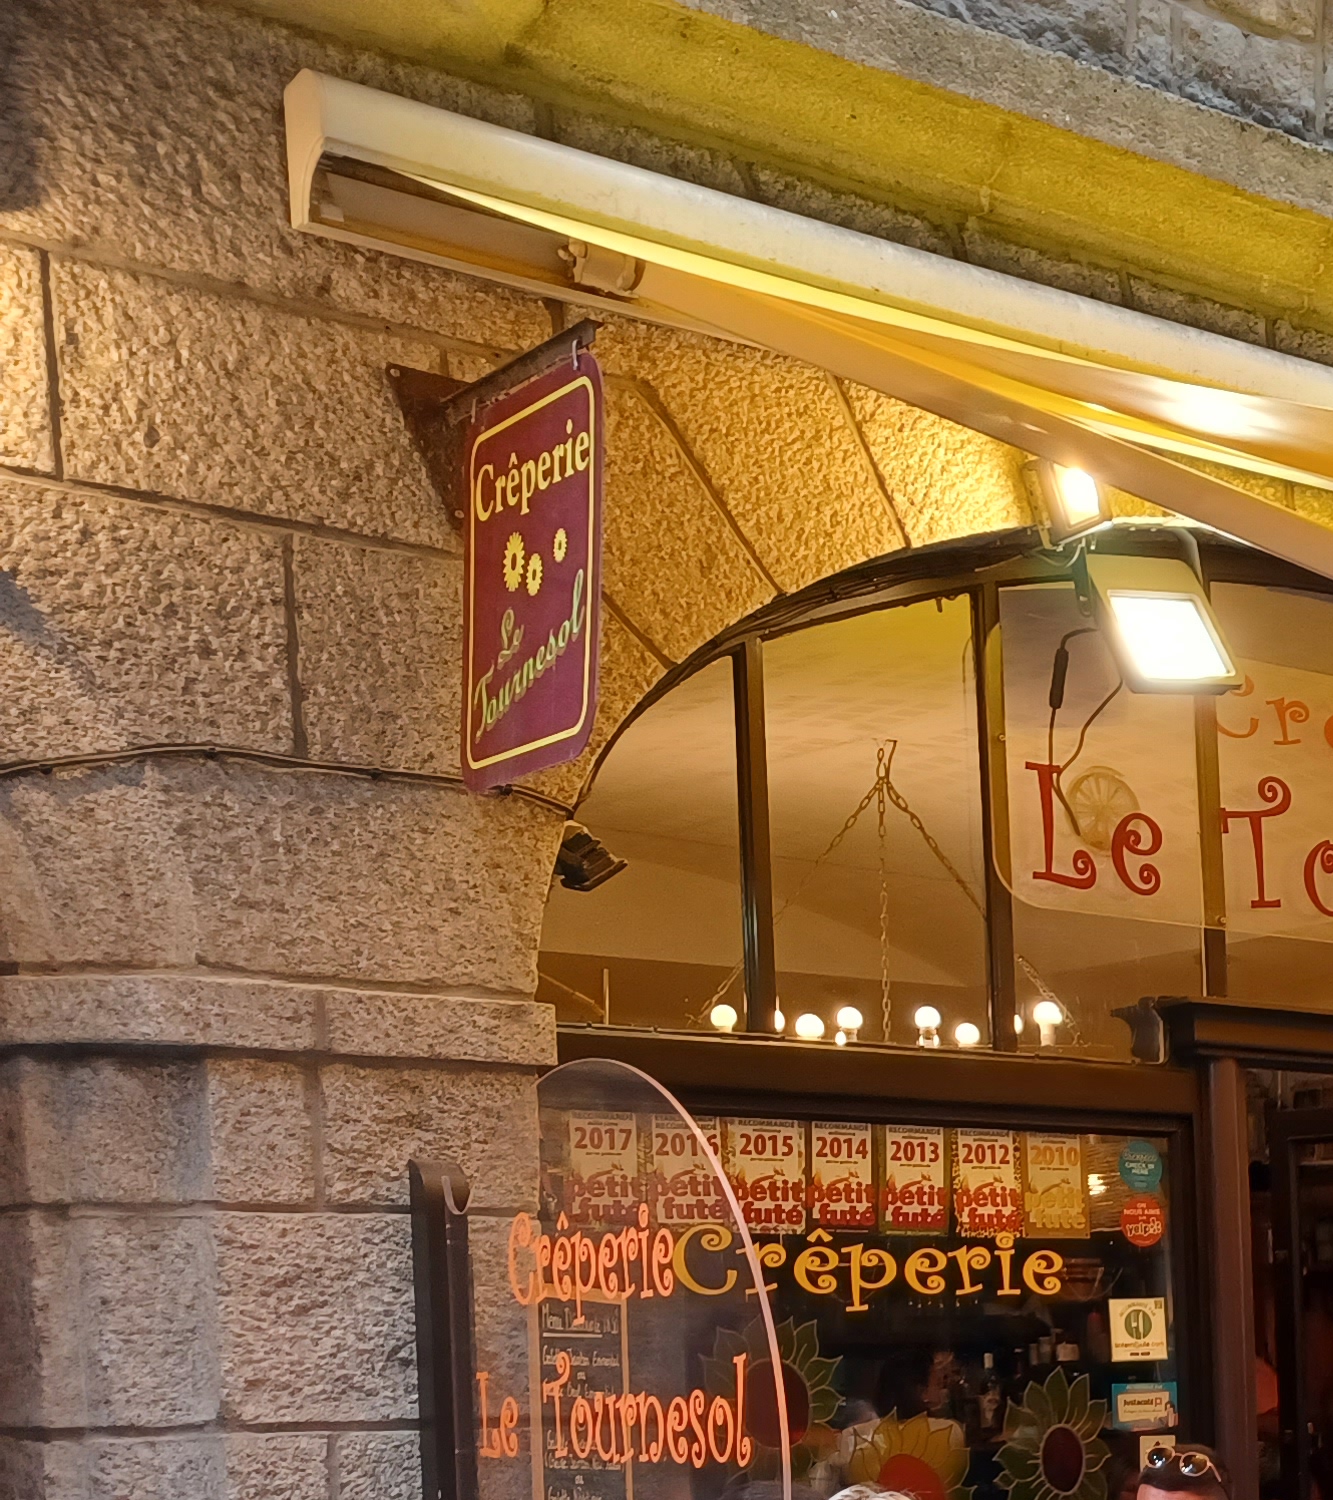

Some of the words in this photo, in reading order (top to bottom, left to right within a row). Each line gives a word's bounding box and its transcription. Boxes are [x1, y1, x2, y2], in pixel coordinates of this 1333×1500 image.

[474, 418, 591, 522] Crêperie
[496, 606, 525, 669] Le
[474, 567, 586, 744] Tournesol
[1024, 761, 1164, 896] Le
[574, 1126, 632, 1151] 2017
[655, 1133, 719, 1157] 2016
[739, 1133, 794, 1157] 2015
[815, 1136, 868, 1160] 2014
[889, 1140, 940, 1163] 2013
[961, 1143, 1010, 1165] 2012
[1029, 1145, 1080, 1167] 2010
[733, 1178, 806, 1206] petit
[806, 1181, 876, 1210] petit
[880, 1185, 947, 1211] petit
[954, 1186, 1021, 1213] petit
[1024, 1187, 1085, 1213] petit
[741, 1201, 804, 1225] futé
[818, 1203, 876, 1226] futé
[891, 1206, 947, 1228] futé
[967, 1208, 1022, 1230] futé
[508, 1203, 674, 1327] Crêperie
[673, 1228, 1064, 1312] Crêperie
[475, 1371, 519, 1458] Le
[542, 1351, 751, 1468] Tournesol
